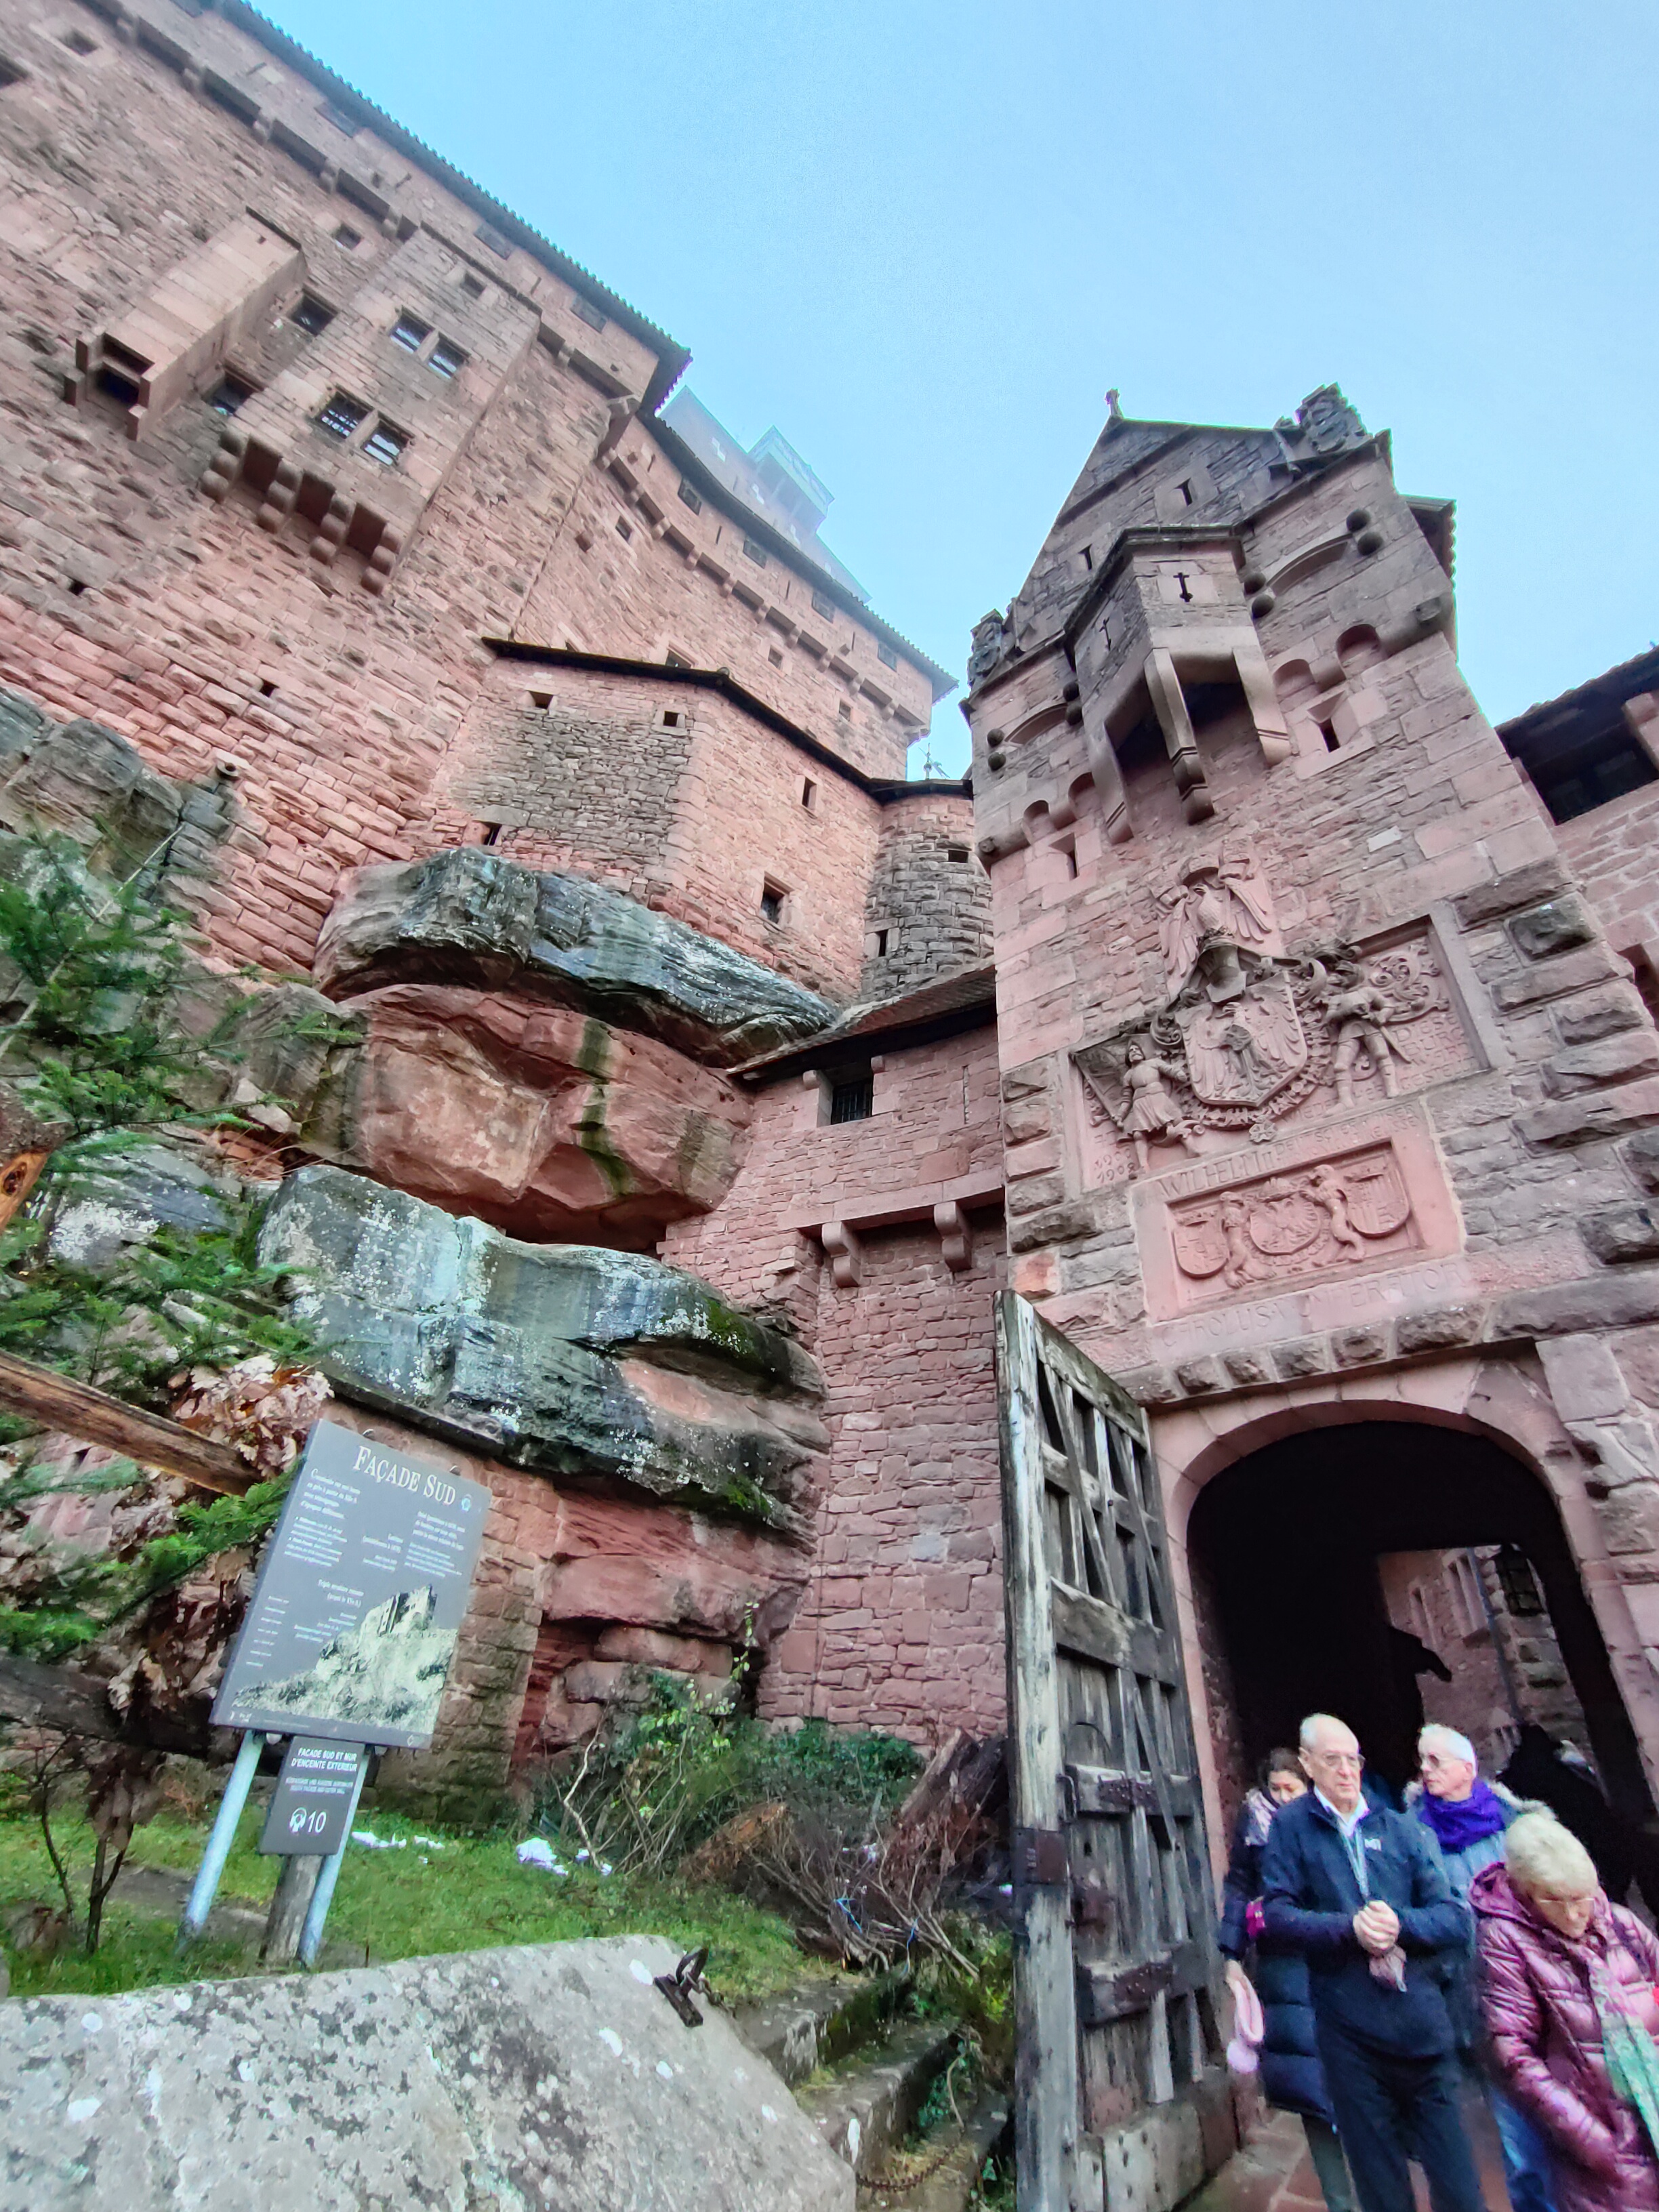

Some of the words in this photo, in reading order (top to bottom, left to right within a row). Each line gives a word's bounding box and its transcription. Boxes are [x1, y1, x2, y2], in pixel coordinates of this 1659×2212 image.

[353, 1446, 422, 1492] FAÇADE
[423, 1474, 456, 1506] SUD
[308, 1810, 327, 1833] 10
